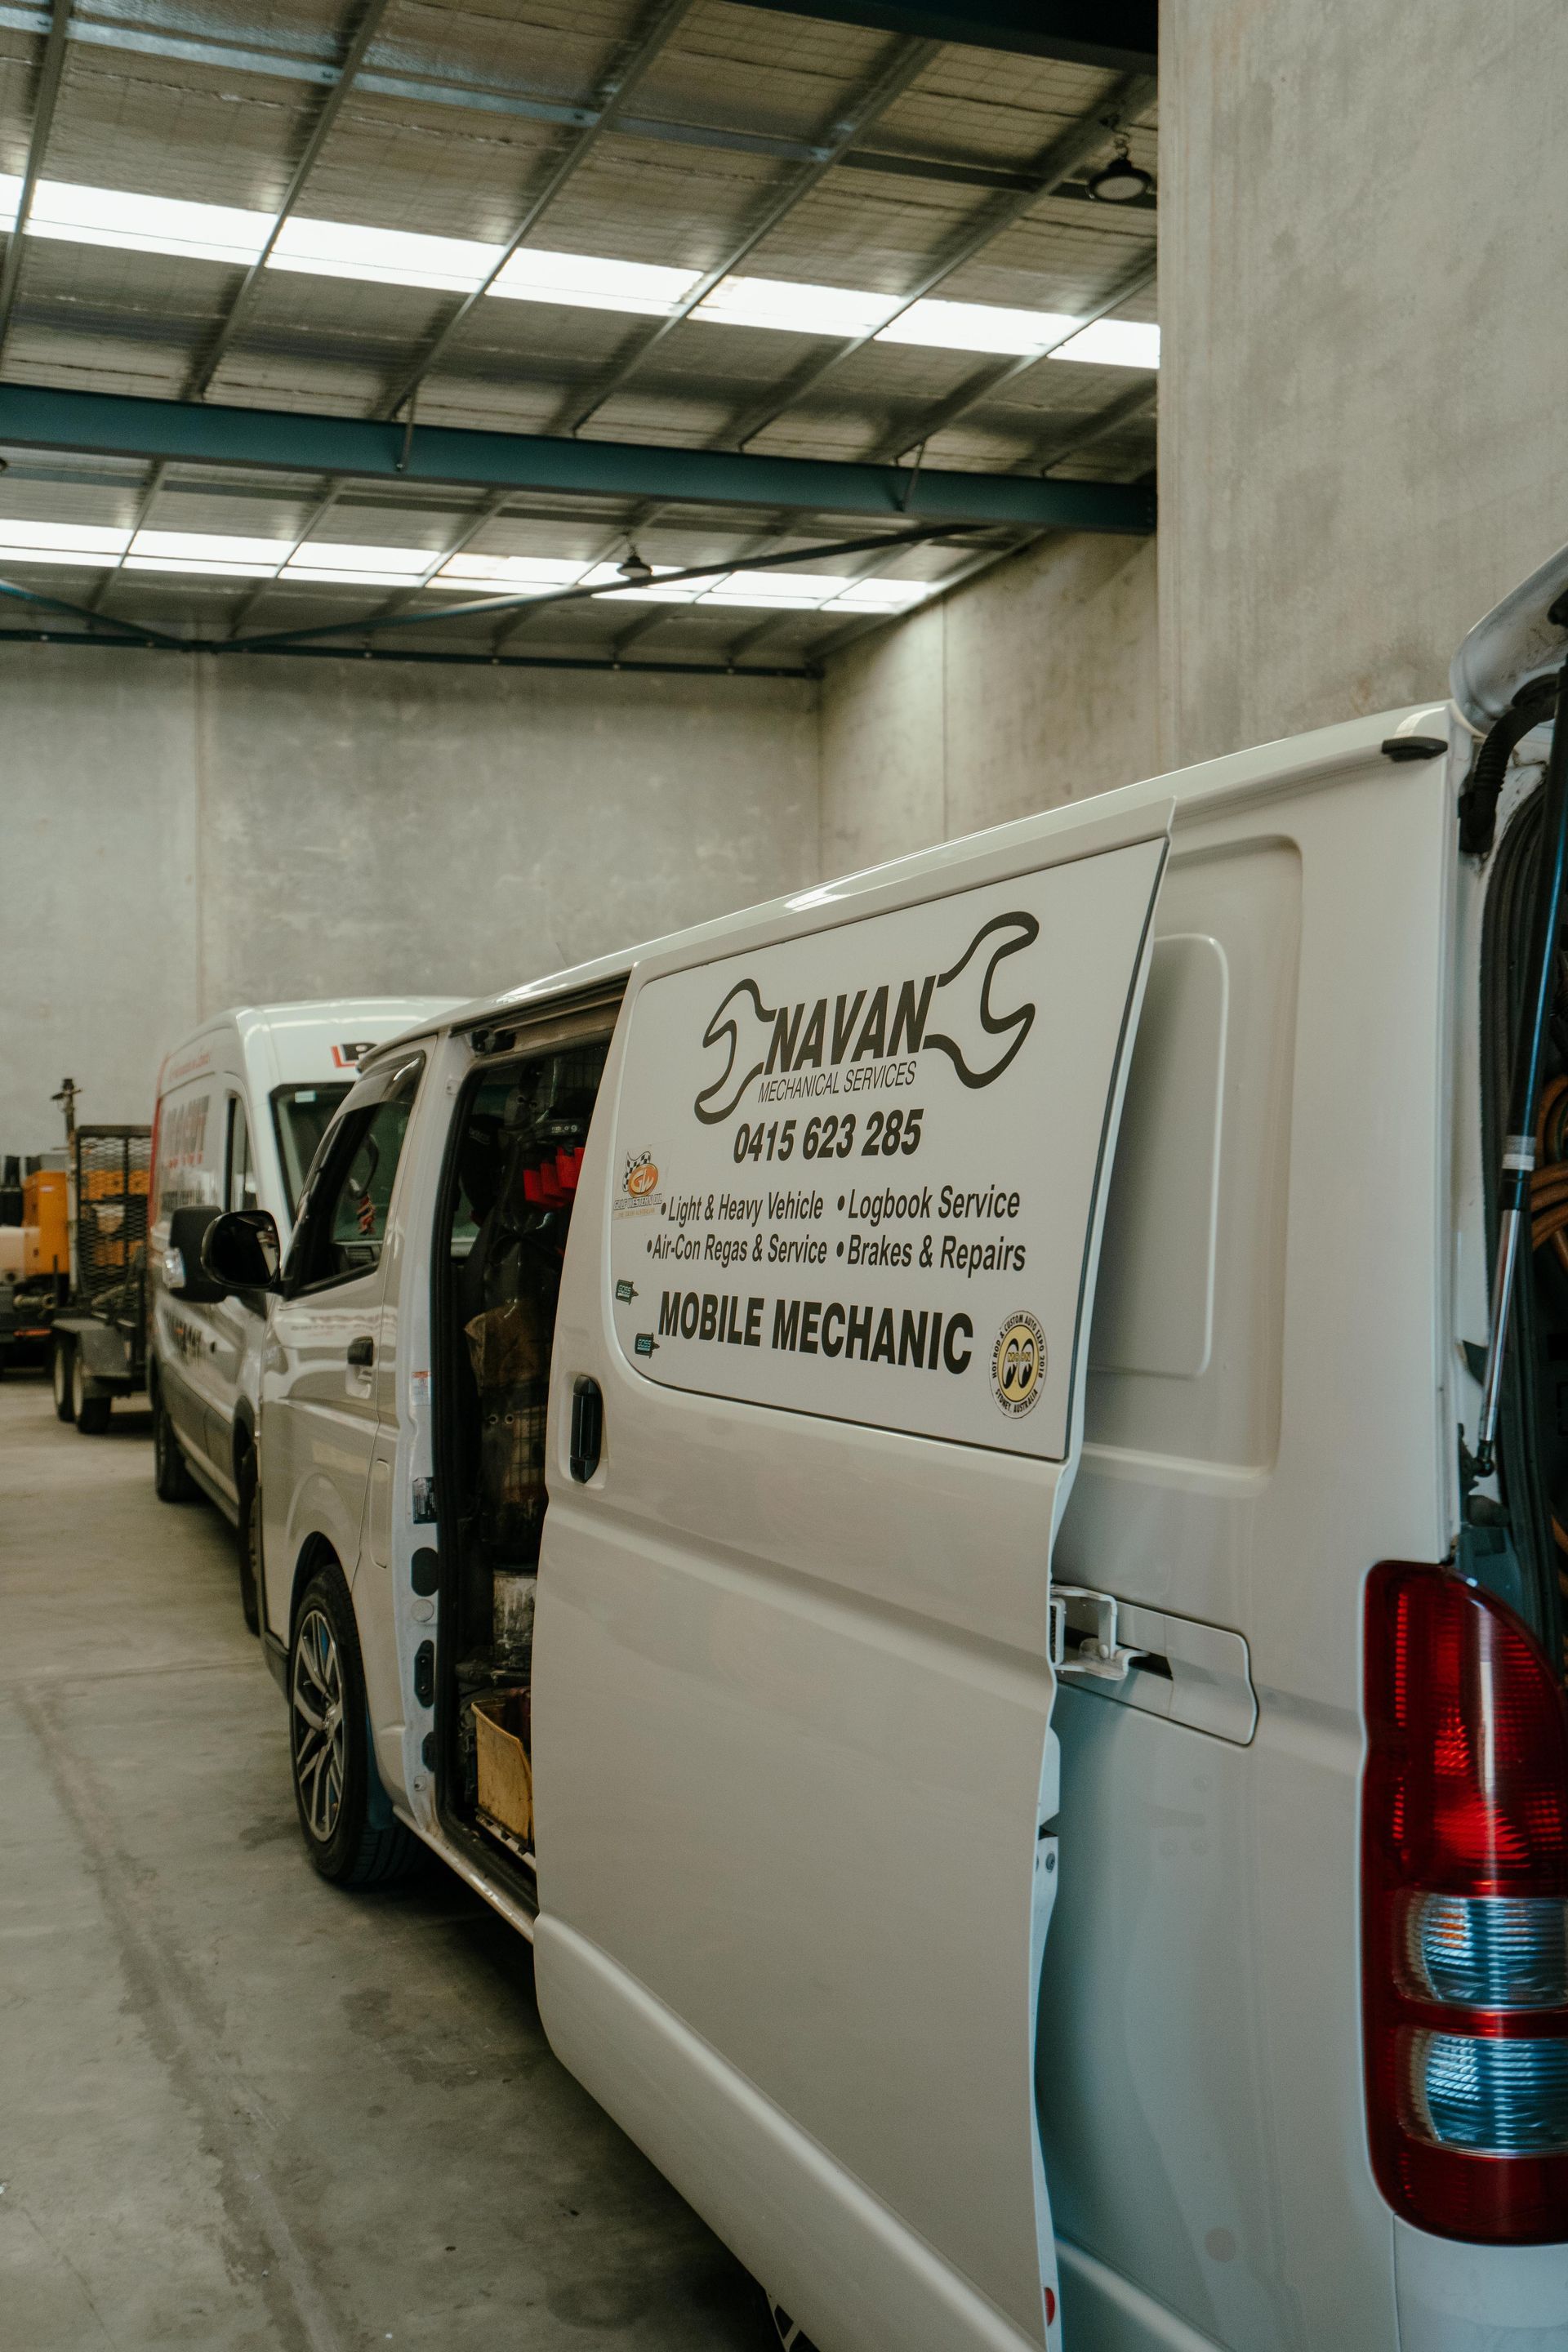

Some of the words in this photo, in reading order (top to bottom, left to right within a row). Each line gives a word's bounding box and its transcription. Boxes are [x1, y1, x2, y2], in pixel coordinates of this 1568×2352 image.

[764, 975, 936, 1075] NAVAN
[758, 1071, 839, 1102] MECHANICAL
[844, 1061, 916, 1094] SERVICES
[733, 1120, 796, 1163] 0415
[803, 1114, 856, 1160] 623
[862, 1108, 924, 1156] 285
[668, 1195, 702, 1228] Light
[704, 1194, 715, 1221] &
[717, 1193, 764, 1228] Heavy
[768, 1190, 824, 1220] Vehicle
[848, 1187, 933, 1227] Logbook
[938, 1184, 1021, 1219] Service
[652, 1233, 701, 1260] Air-Con
[704, 1234, 748, 1269] Regas
[751, 1234, 763, 1263] &
[768, 1234, 827, 1264] Service
[847, 1234, 913, 1268] Brakes
[919, 1234, 933, 1268] &
[939, 1236, 1027, 1279] Repairs
[658, 1290, 764, 1347] MOBILE
[772, 1298, 973, 1374] MECHANIC
[1004, 1314, 1024, 1332] CUSTOM
[1024, 1316, 1037, 1331] AUTO
